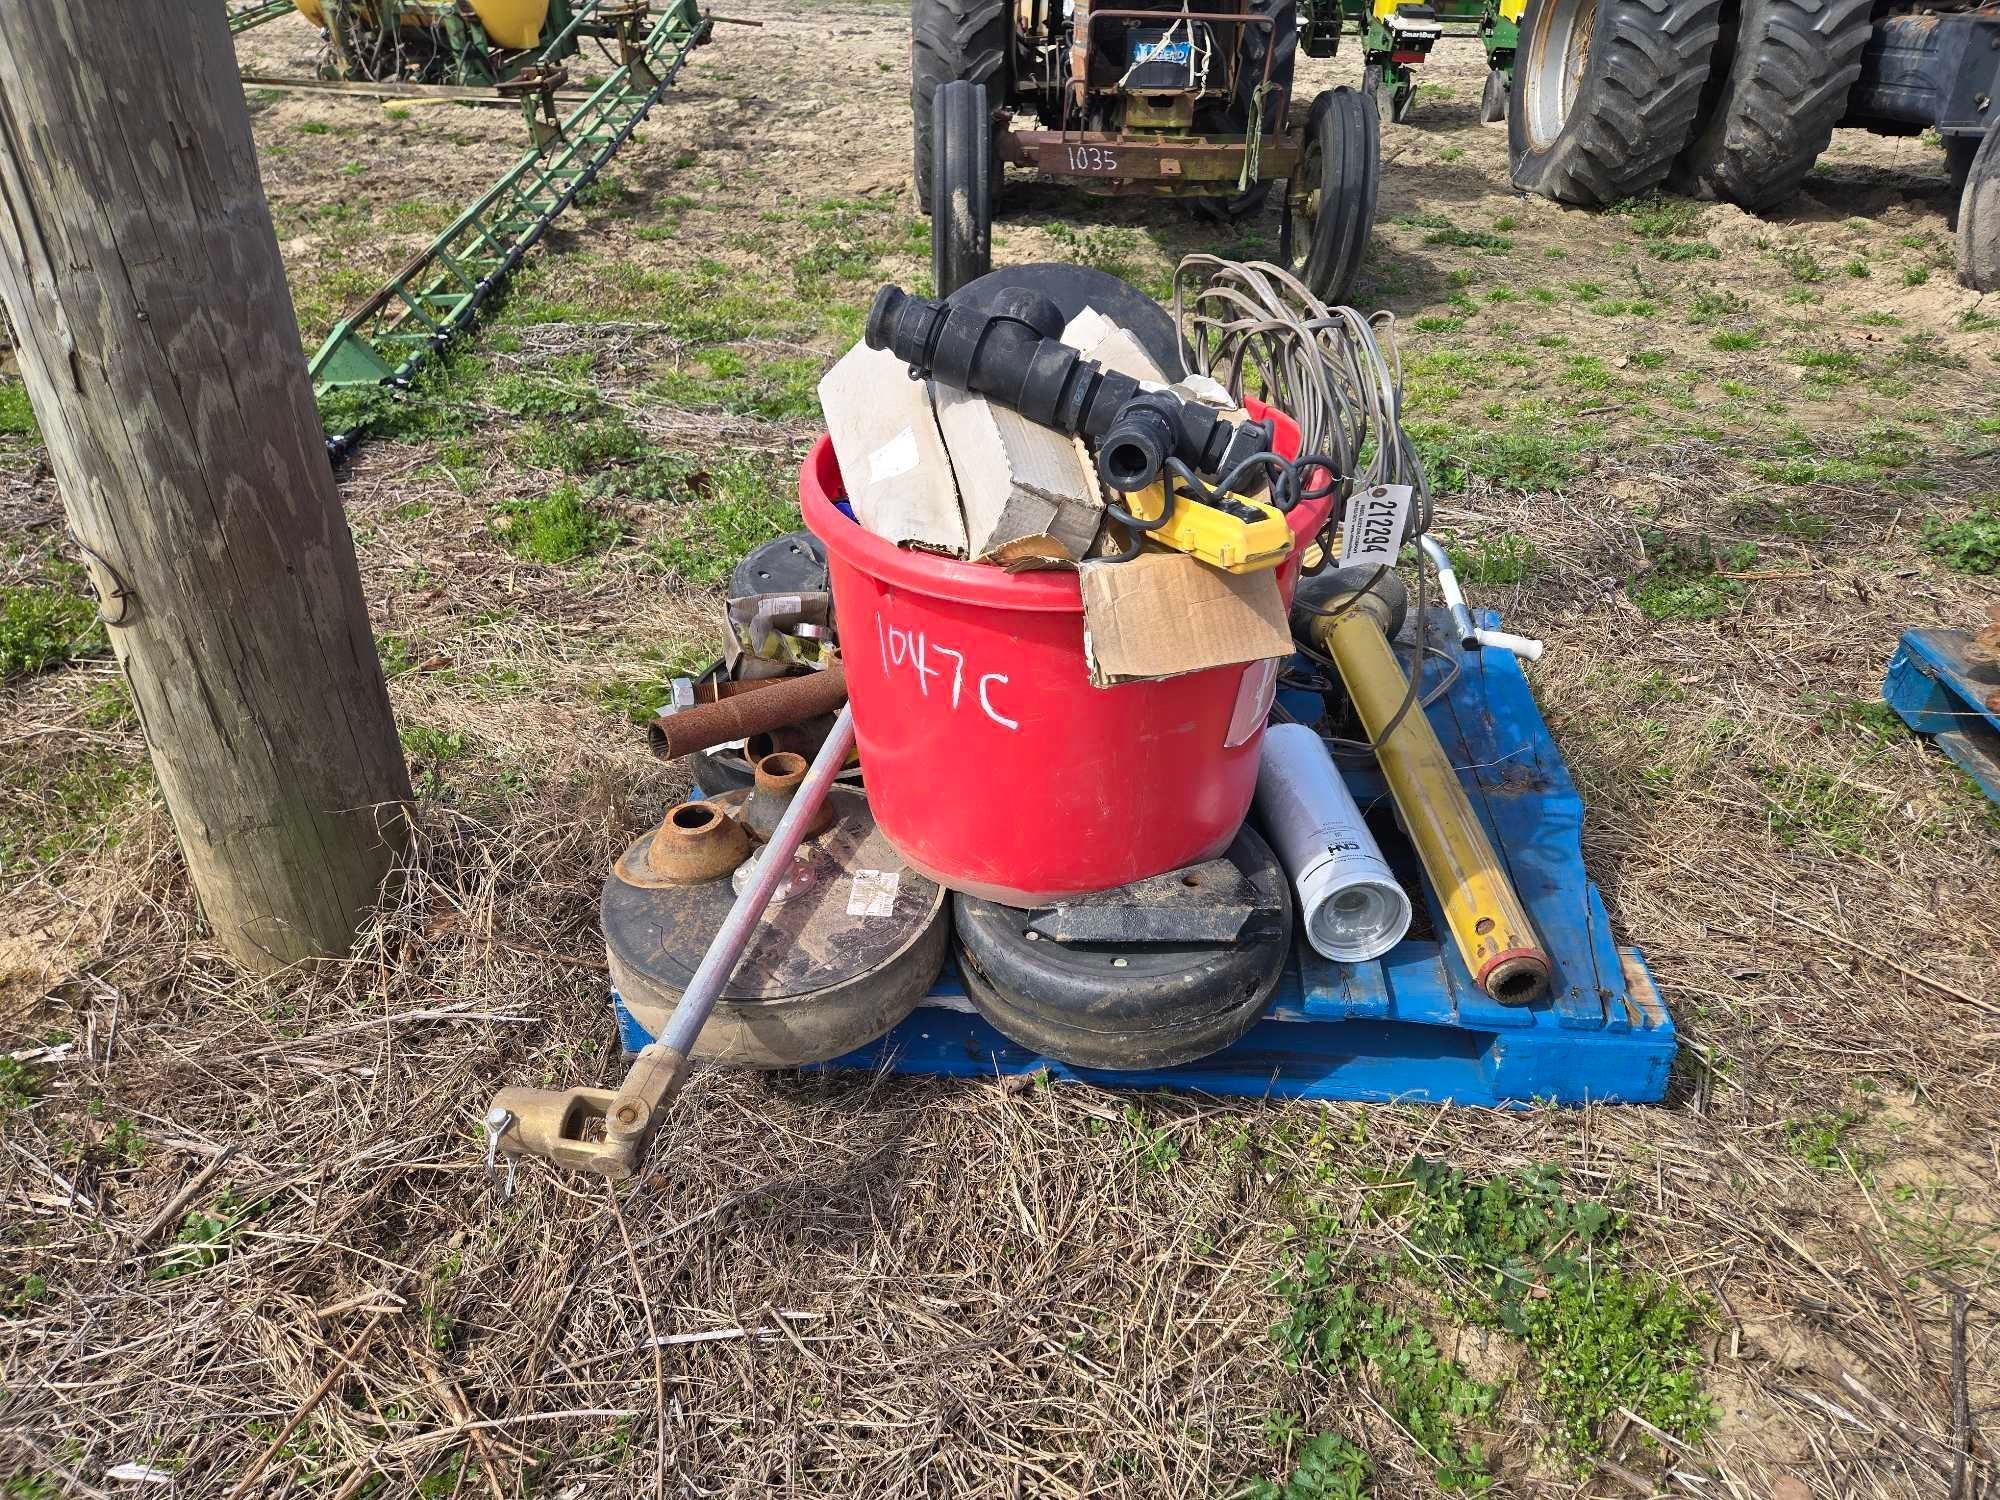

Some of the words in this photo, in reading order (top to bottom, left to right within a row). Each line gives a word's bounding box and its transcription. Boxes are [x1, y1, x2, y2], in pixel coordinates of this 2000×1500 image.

[1401, 31, 1436, 39] SmartBox
[1068, 146, 1118, 170] 1035
[1361, 500, 1398, 553] 212294
[876, 610, 1019, 730] 1047C
[1328, 843, 1360, 854] CNH
